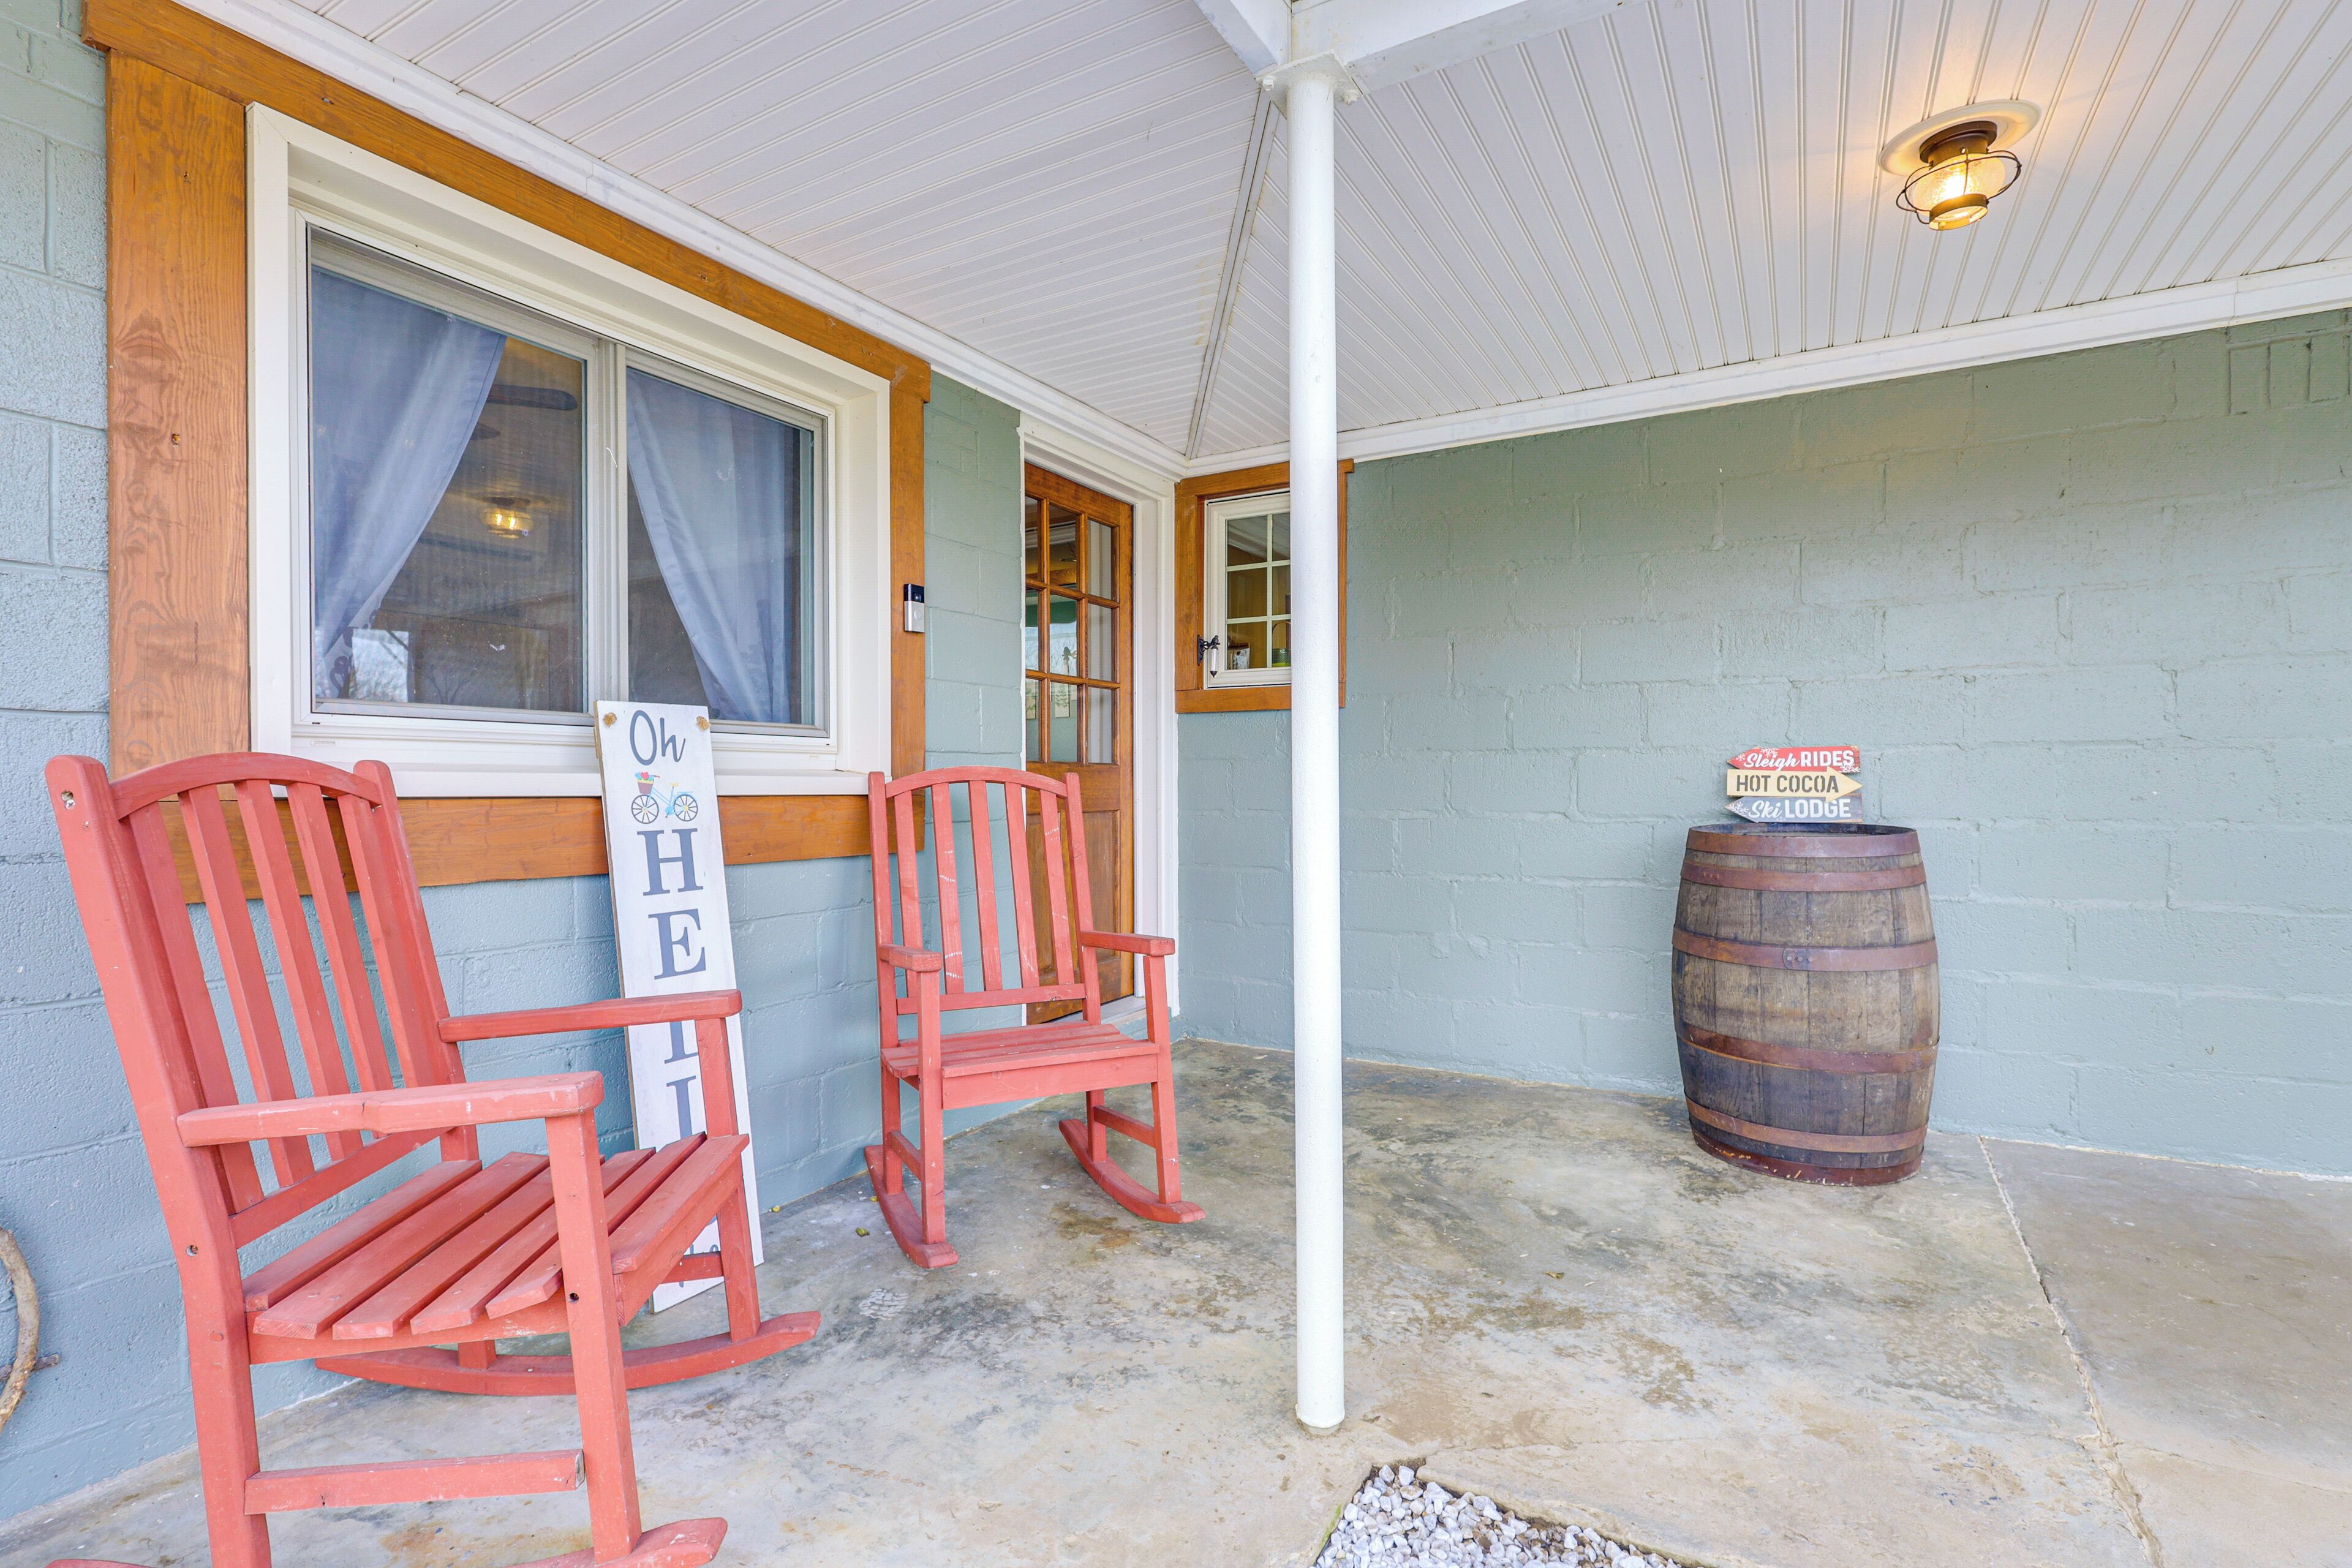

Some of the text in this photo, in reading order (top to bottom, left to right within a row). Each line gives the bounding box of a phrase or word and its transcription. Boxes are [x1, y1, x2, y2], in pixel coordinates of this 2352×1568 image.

[630, 710, 686, 766] Oh
[1744, 750, 1855, 771] Sleigh RIDES
[1736, 775, 1839, 793] HOT COCOA
[1749, 799, 1851, 818] Ski LODGE
